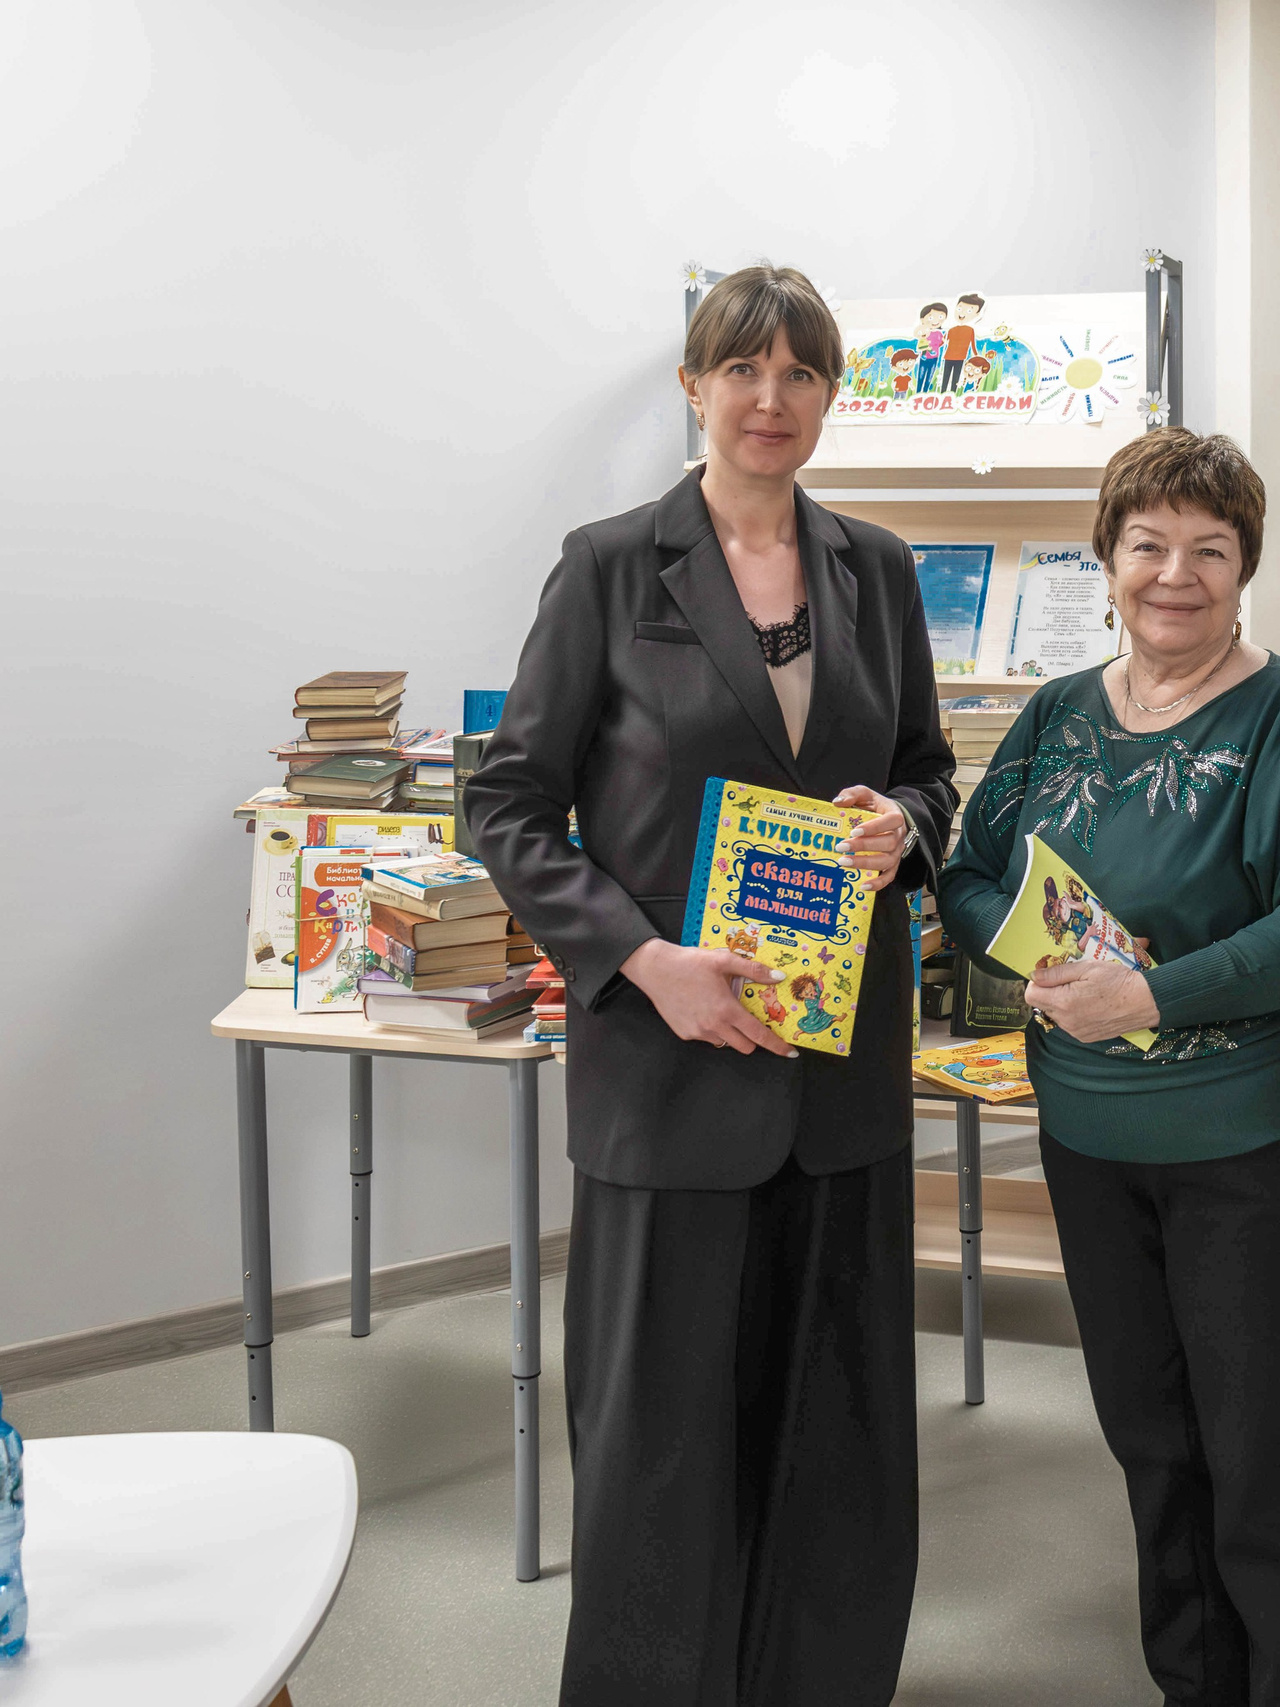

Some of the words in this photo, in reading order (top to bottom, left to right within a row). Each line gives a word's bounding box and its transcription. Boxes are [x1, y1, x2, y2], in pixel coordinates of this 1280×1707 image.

[836, 400, 889, 414] 2024
[913, 395, 954, 411] ГОД
[963, 394, 1033, 411] СЕМЬИ
[485, 705, 494, 717] 4
[765, 806, 788, 818] САМЫЕ
[788, 811, 814, 823] ЛУЧШИЕ
[815, 817, 839, 829] СКАЗКИ
[279, 871, 295, 881] ПРА
[776, 885, 803, 901] для
[744, 894, 832, 925] малышей
